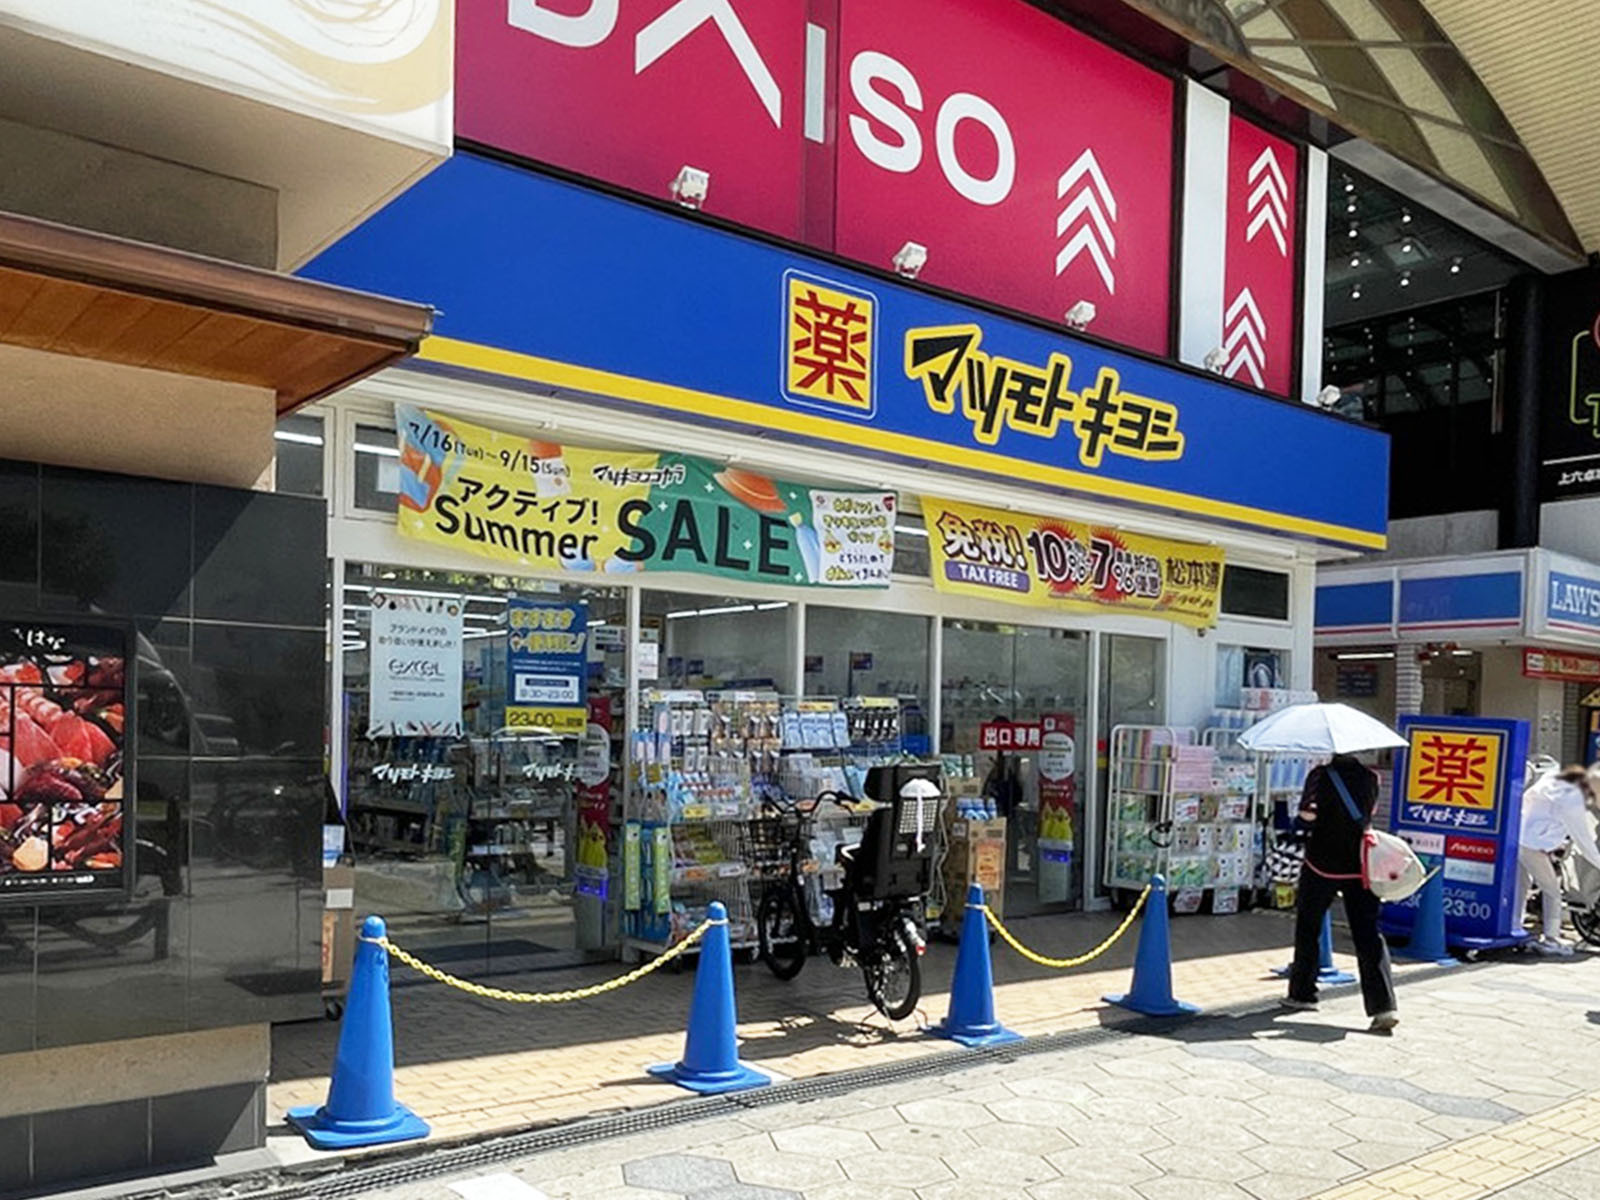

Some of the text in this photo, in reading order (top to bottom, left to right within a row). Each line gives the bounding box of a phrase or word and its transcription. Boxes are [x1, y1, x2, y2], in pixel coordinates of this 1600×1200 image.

[507, 0, 1017, 206] AISO
[793, 290, 868, 402] 薬
[909, 330, 1182, 461] マツモトキヨシ
[457, 476, 599, 526] アクティブ!
[434, 494, 792, 577] Summer SALE
[958, 563, 1019, 589] TAX FREE
[1552, 580, 1600, 617] LAWS
[372, 762, 456, 784] マツモトキヨシ
[1417, 735, 1488, 806] 薬
[1407, 804, 1489, 827] マツモトキヨシ
[1442, 897, 1492, 920] 23:00
